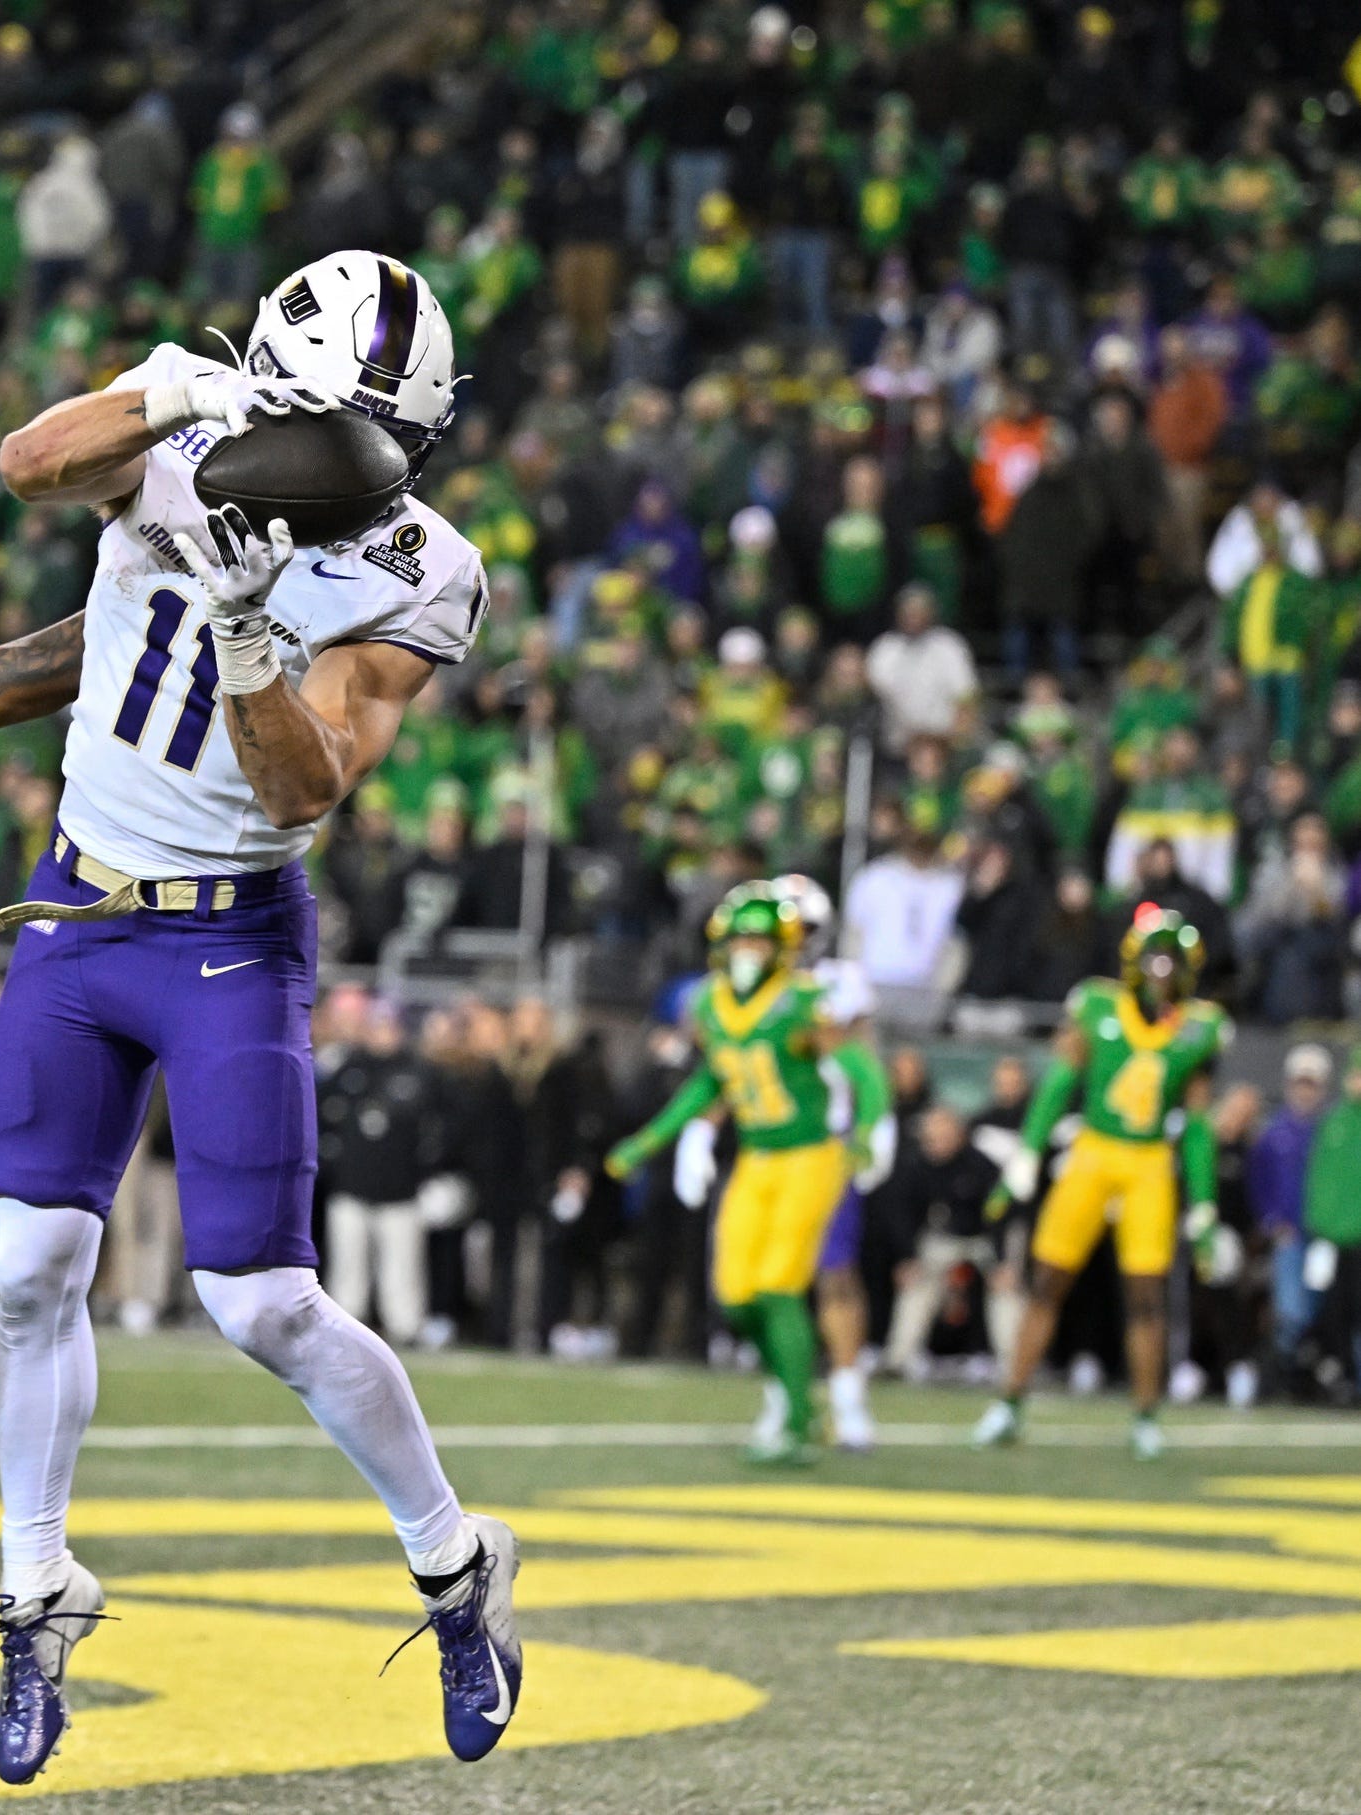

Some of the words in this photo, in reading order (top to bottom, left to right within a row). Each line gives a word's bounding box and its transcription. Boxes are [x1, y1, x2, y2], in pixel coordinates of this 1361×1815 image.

[350, 388, 399, 417] DUKES
[367, 548, 394, 563] FIRST
[393, 558, 423, 579] ROUND
[380, 545, 418, 566] PLAYOFF
[112, 585, 220, 777] 11
[1104, 1051, 1166, 1134] 4
